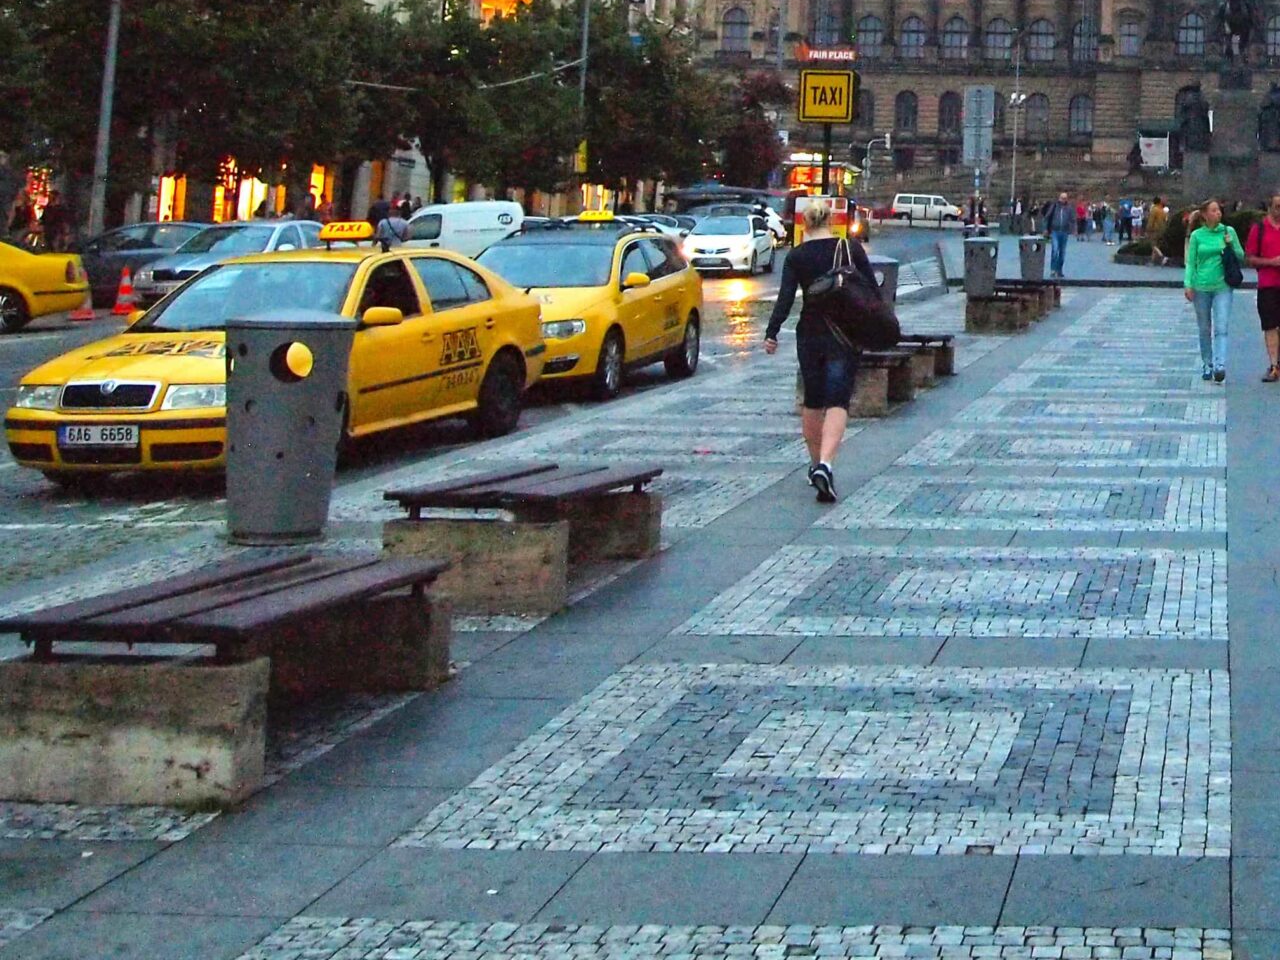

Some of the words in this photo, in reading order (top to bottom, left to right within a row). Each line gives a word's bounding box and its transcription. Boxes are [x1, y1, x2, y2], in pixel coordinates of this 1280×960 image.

[809, 50, 828, 59] FAIR
[828, 50, 853, 60] PLACE
[810, 86, 843, 106] TAXI
[328, 223, 363, 233] TAXI
[440, 326, 482, 365] AAA
[68, 427, 92, 441] 6A6
